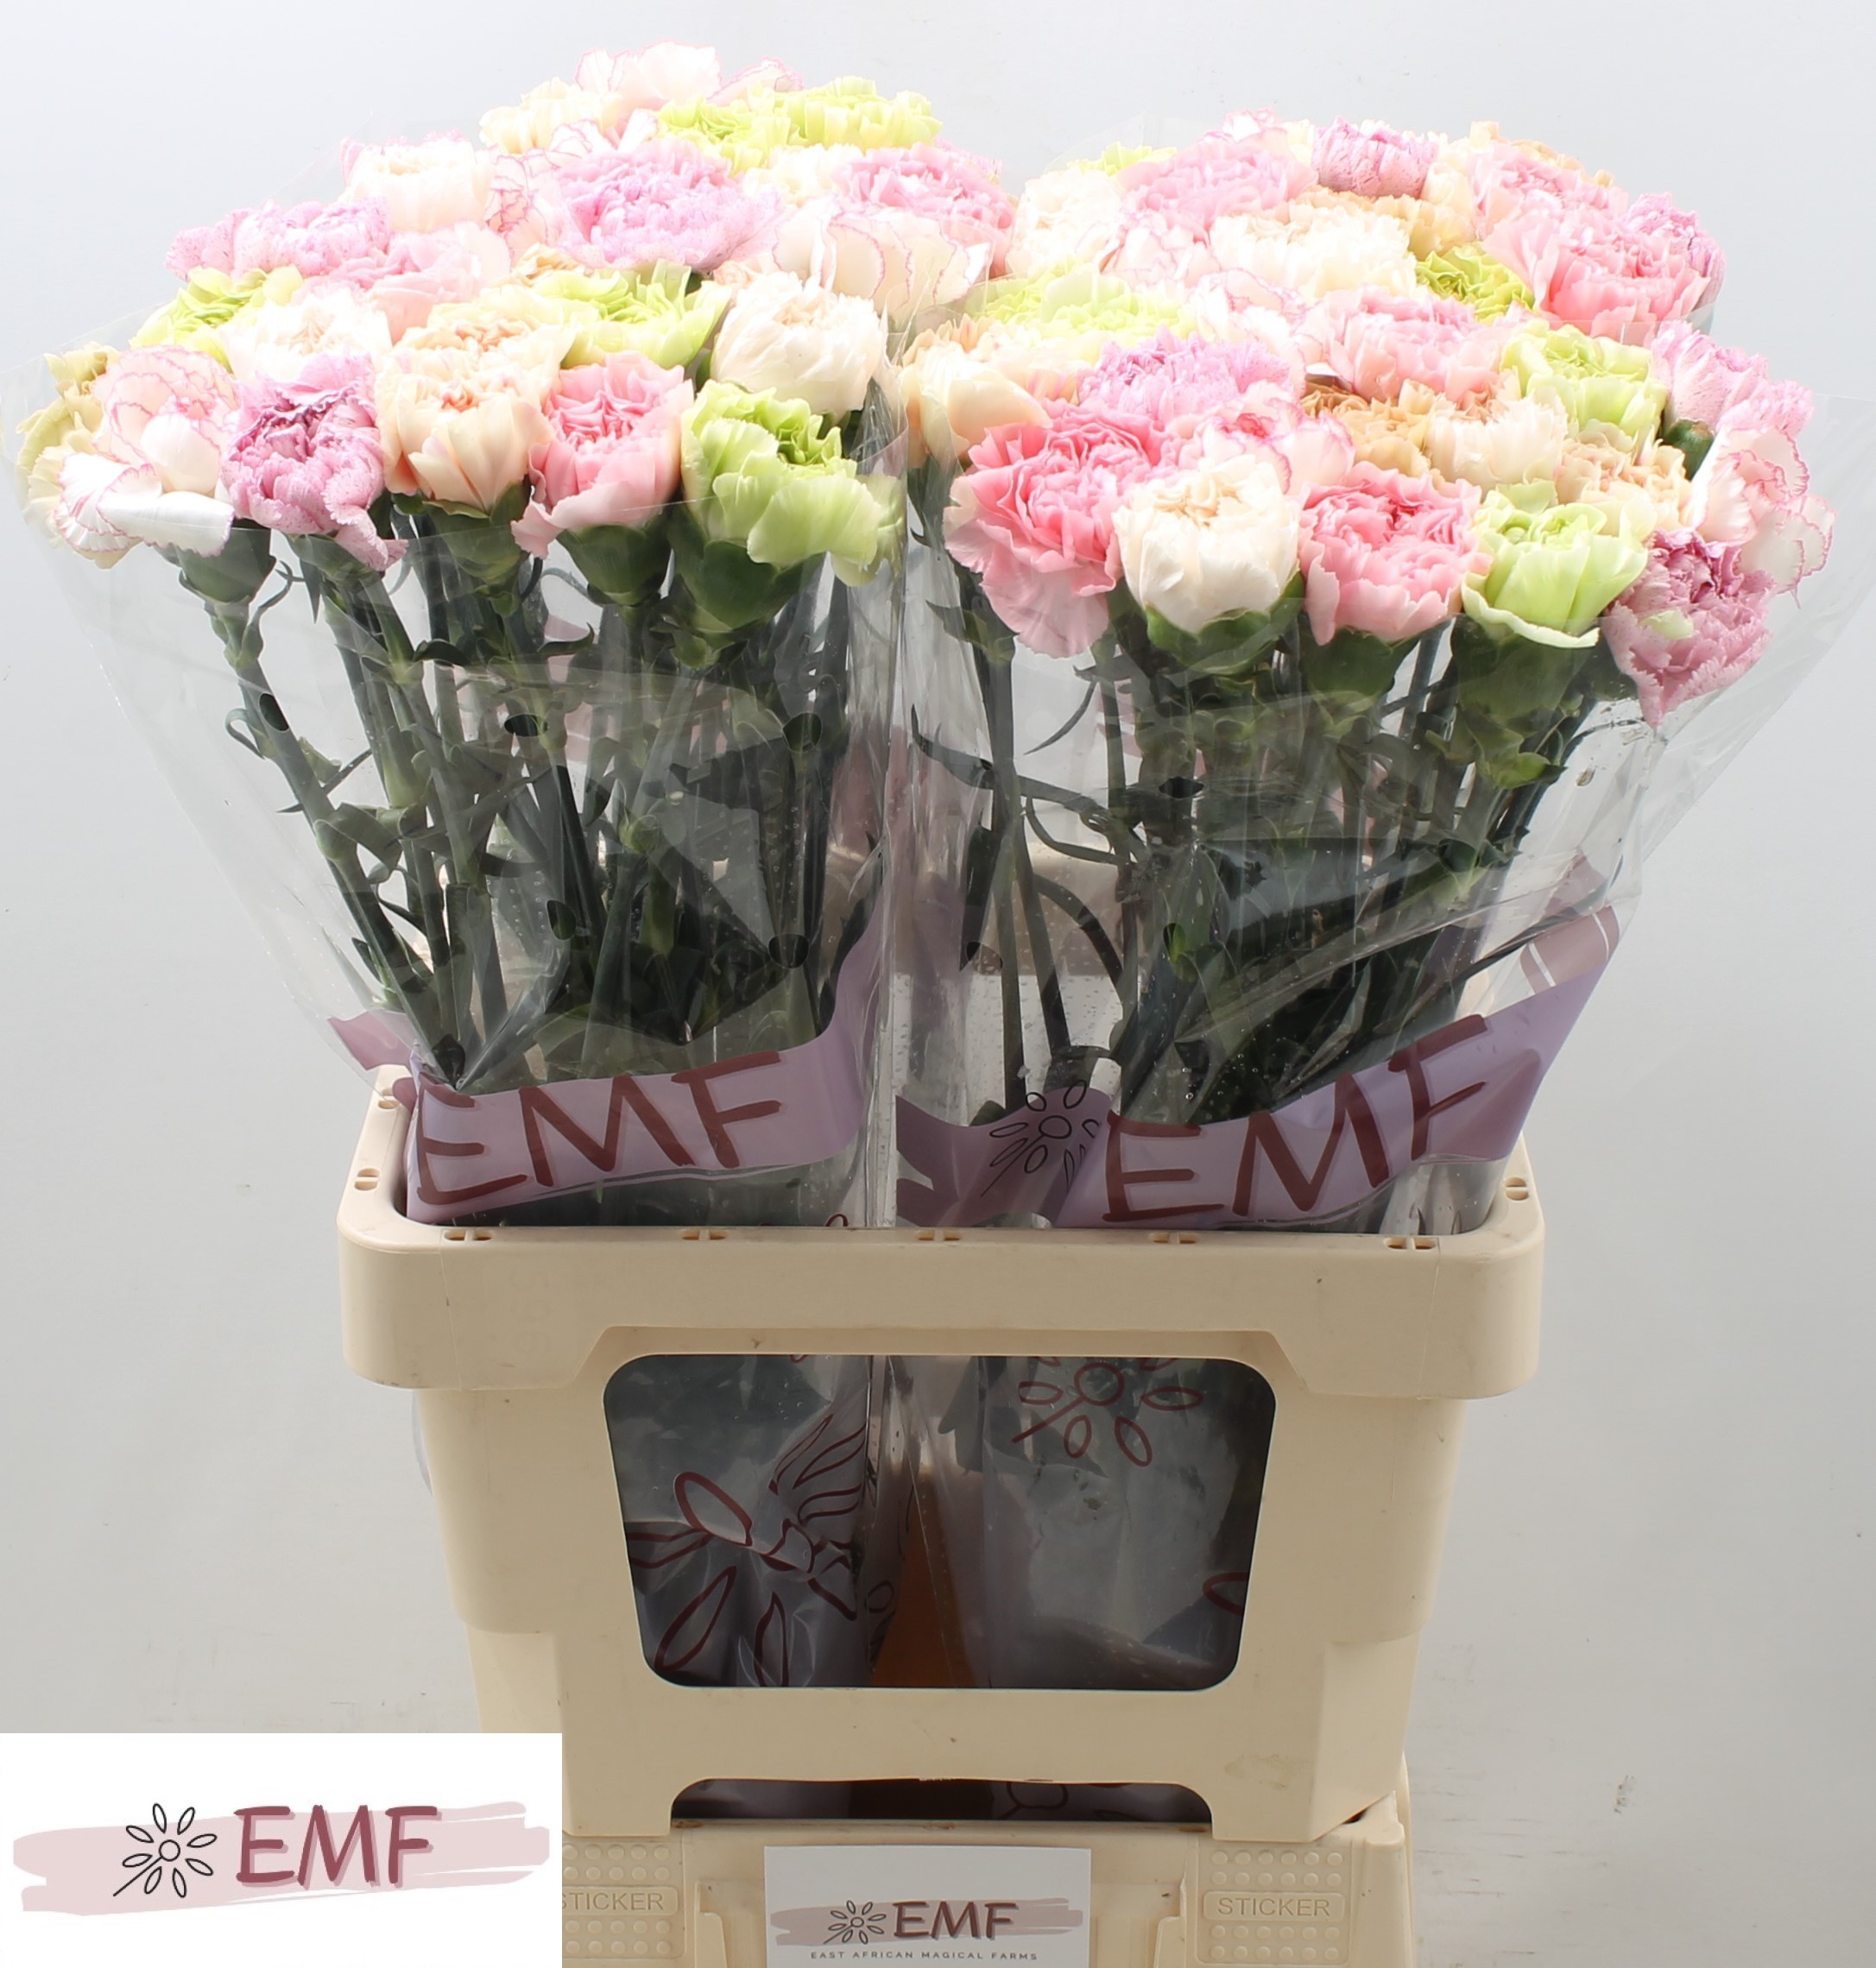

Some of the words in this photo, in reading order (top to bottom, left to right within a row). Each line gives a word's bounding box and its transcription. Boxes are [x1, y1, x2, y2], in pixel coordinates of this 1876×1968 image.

[416, 1050, 788, 1205] EMF
[1101, 1013, 1489, 1222] EMF
[562, 1892, 664, 1911] TICKER
[1217, 1897, 1330, 1917] STICKER
[892, 1901, 1020, 1940] EMF
[811, 1951, 845, 1959] EAST
[852, 1951, 913, 1959] AFRICAN
[921, 1951, 983, 1960] MAGICAL
[991, 1952, 1037, 1961] FARMS
